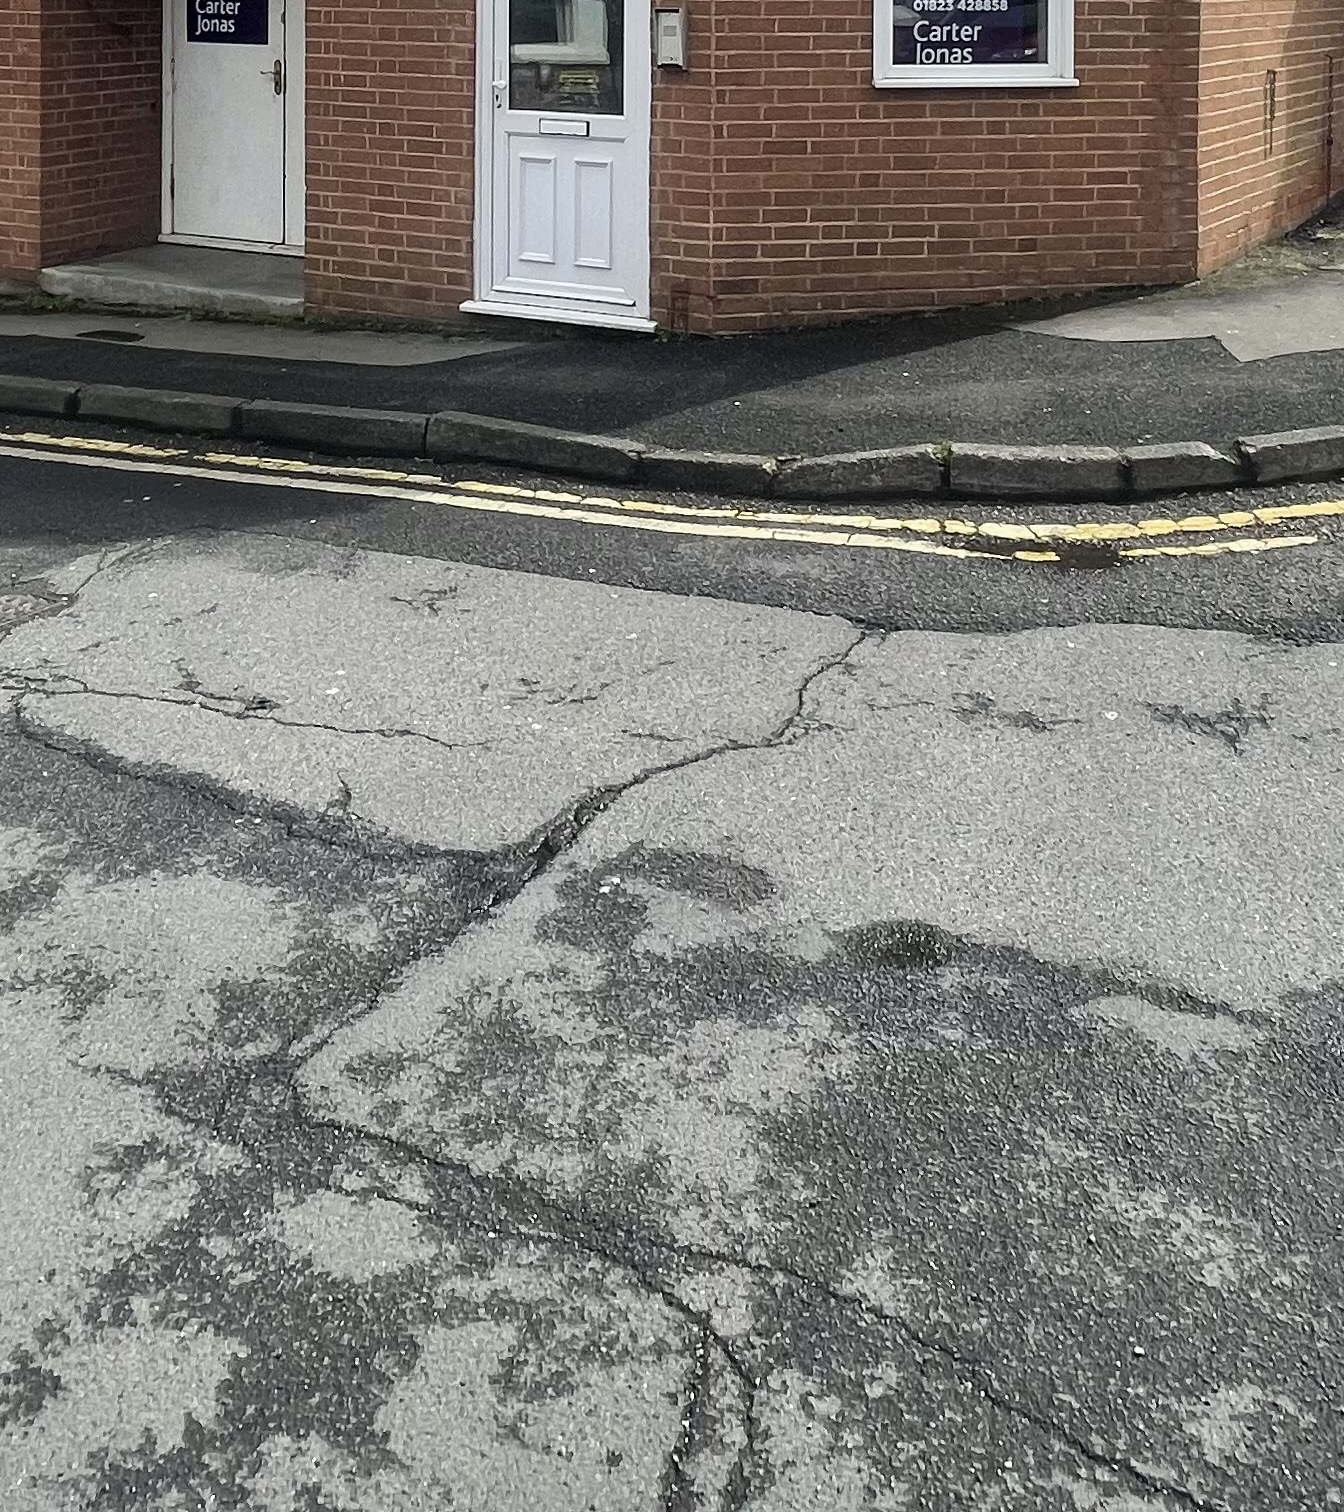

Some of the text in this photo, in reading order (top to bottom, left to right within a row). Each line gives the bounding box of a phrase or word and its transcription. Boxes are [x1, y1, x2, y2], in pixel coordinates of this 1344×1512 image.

[913, 0, 1009, 12] 01823 428858
[194, 14, 235, 36] Jonas
[913, 20, 983, 42] Carter
